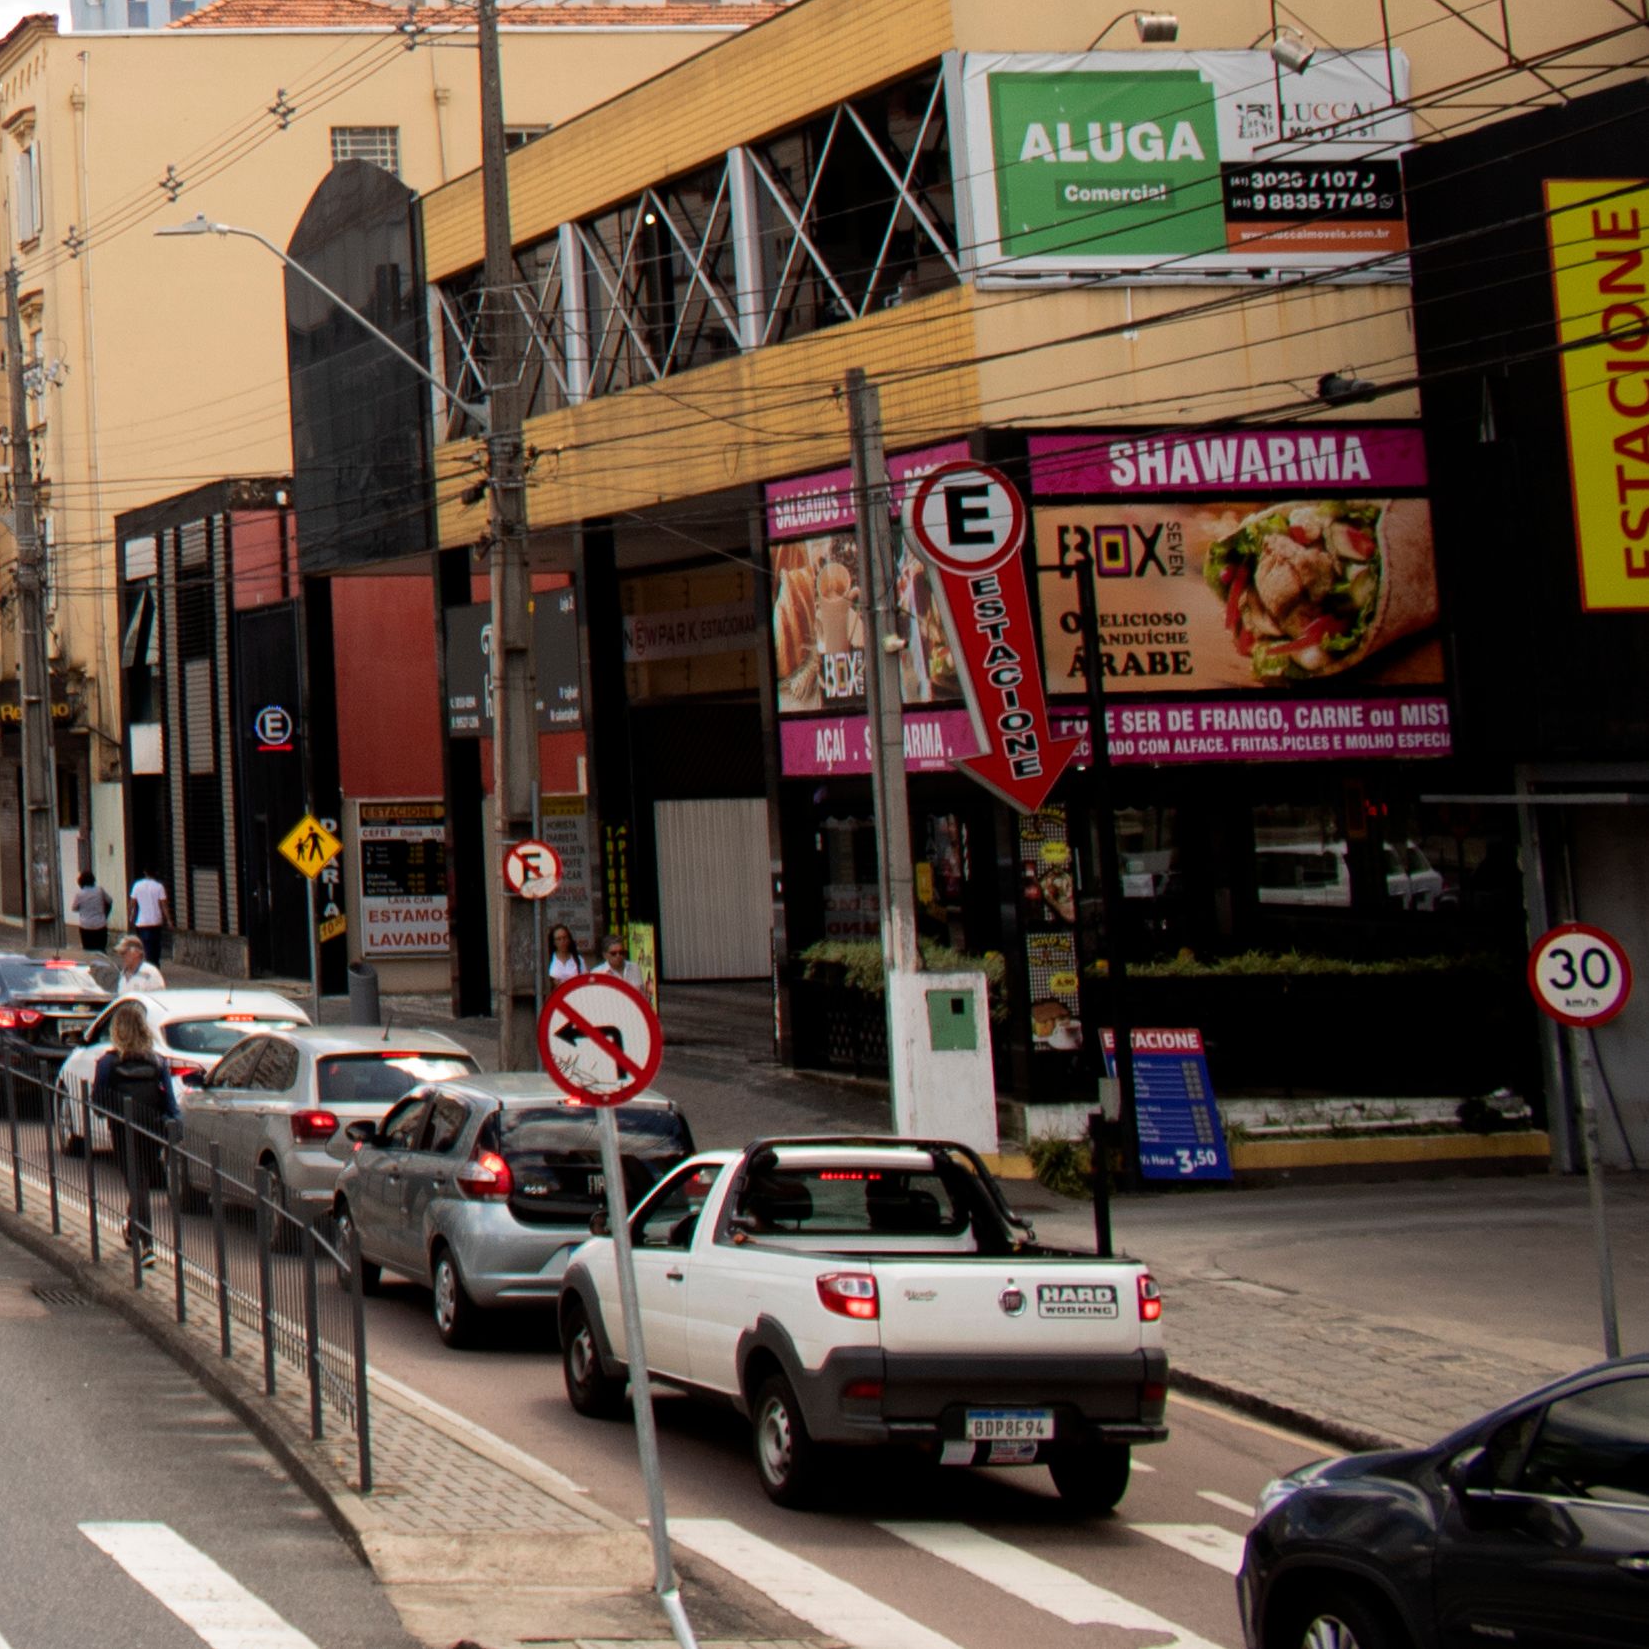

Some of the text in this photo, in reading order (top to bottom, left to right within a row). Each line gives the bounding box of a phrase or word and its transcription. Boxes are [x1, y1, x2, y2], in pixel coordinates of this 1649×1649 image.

[1019, 120, 1206, 163] ALUGA
[1064, 184, 1167, 203] Comercial
[1253, 193, 1266, 210] 9
[1108, 435, 1371, 487] SHAWARMA
[775, 485, 839, 530] SALGADOS
[943, 484, 995, 545] E
[1165, 521, 1184, 577] SEVEN
[1099, 612, 1187, 628] ELICIOSO
[1098, 629, 1189, 646] ANDUÍCHE
[968, 574, 1042, 781] ESTACIONE
[264, 714, 284, 738] E
[1058, 712, 1115, 734] POE
[1121, 710, 1161, 734] SER
[1168, 709, 1194, 732] DE
[1201, 707, 1289, 733] FRANGO,
[1295, 707, 1363, 730] CARNE
[1370, 708, 1394, 727] ou
[816, 720, 846, 771] AÇAÍ
[1139, 737, 1171, 754] COM
[1333, 735, 1342, 749] E
[1346, 733, 1394, 749] MOLHO
[1548, 948, 1611, 990] 30
[1565, 997, 1599, 1007] km/h
[1103, 1032, 1199, 1049] ETACIONE
[1176, 1149, 1217, 1174] 3,50
[1041, 1286, 1113, 1302] HARD
[1045, 1305, 1113, 1316] WORKING
